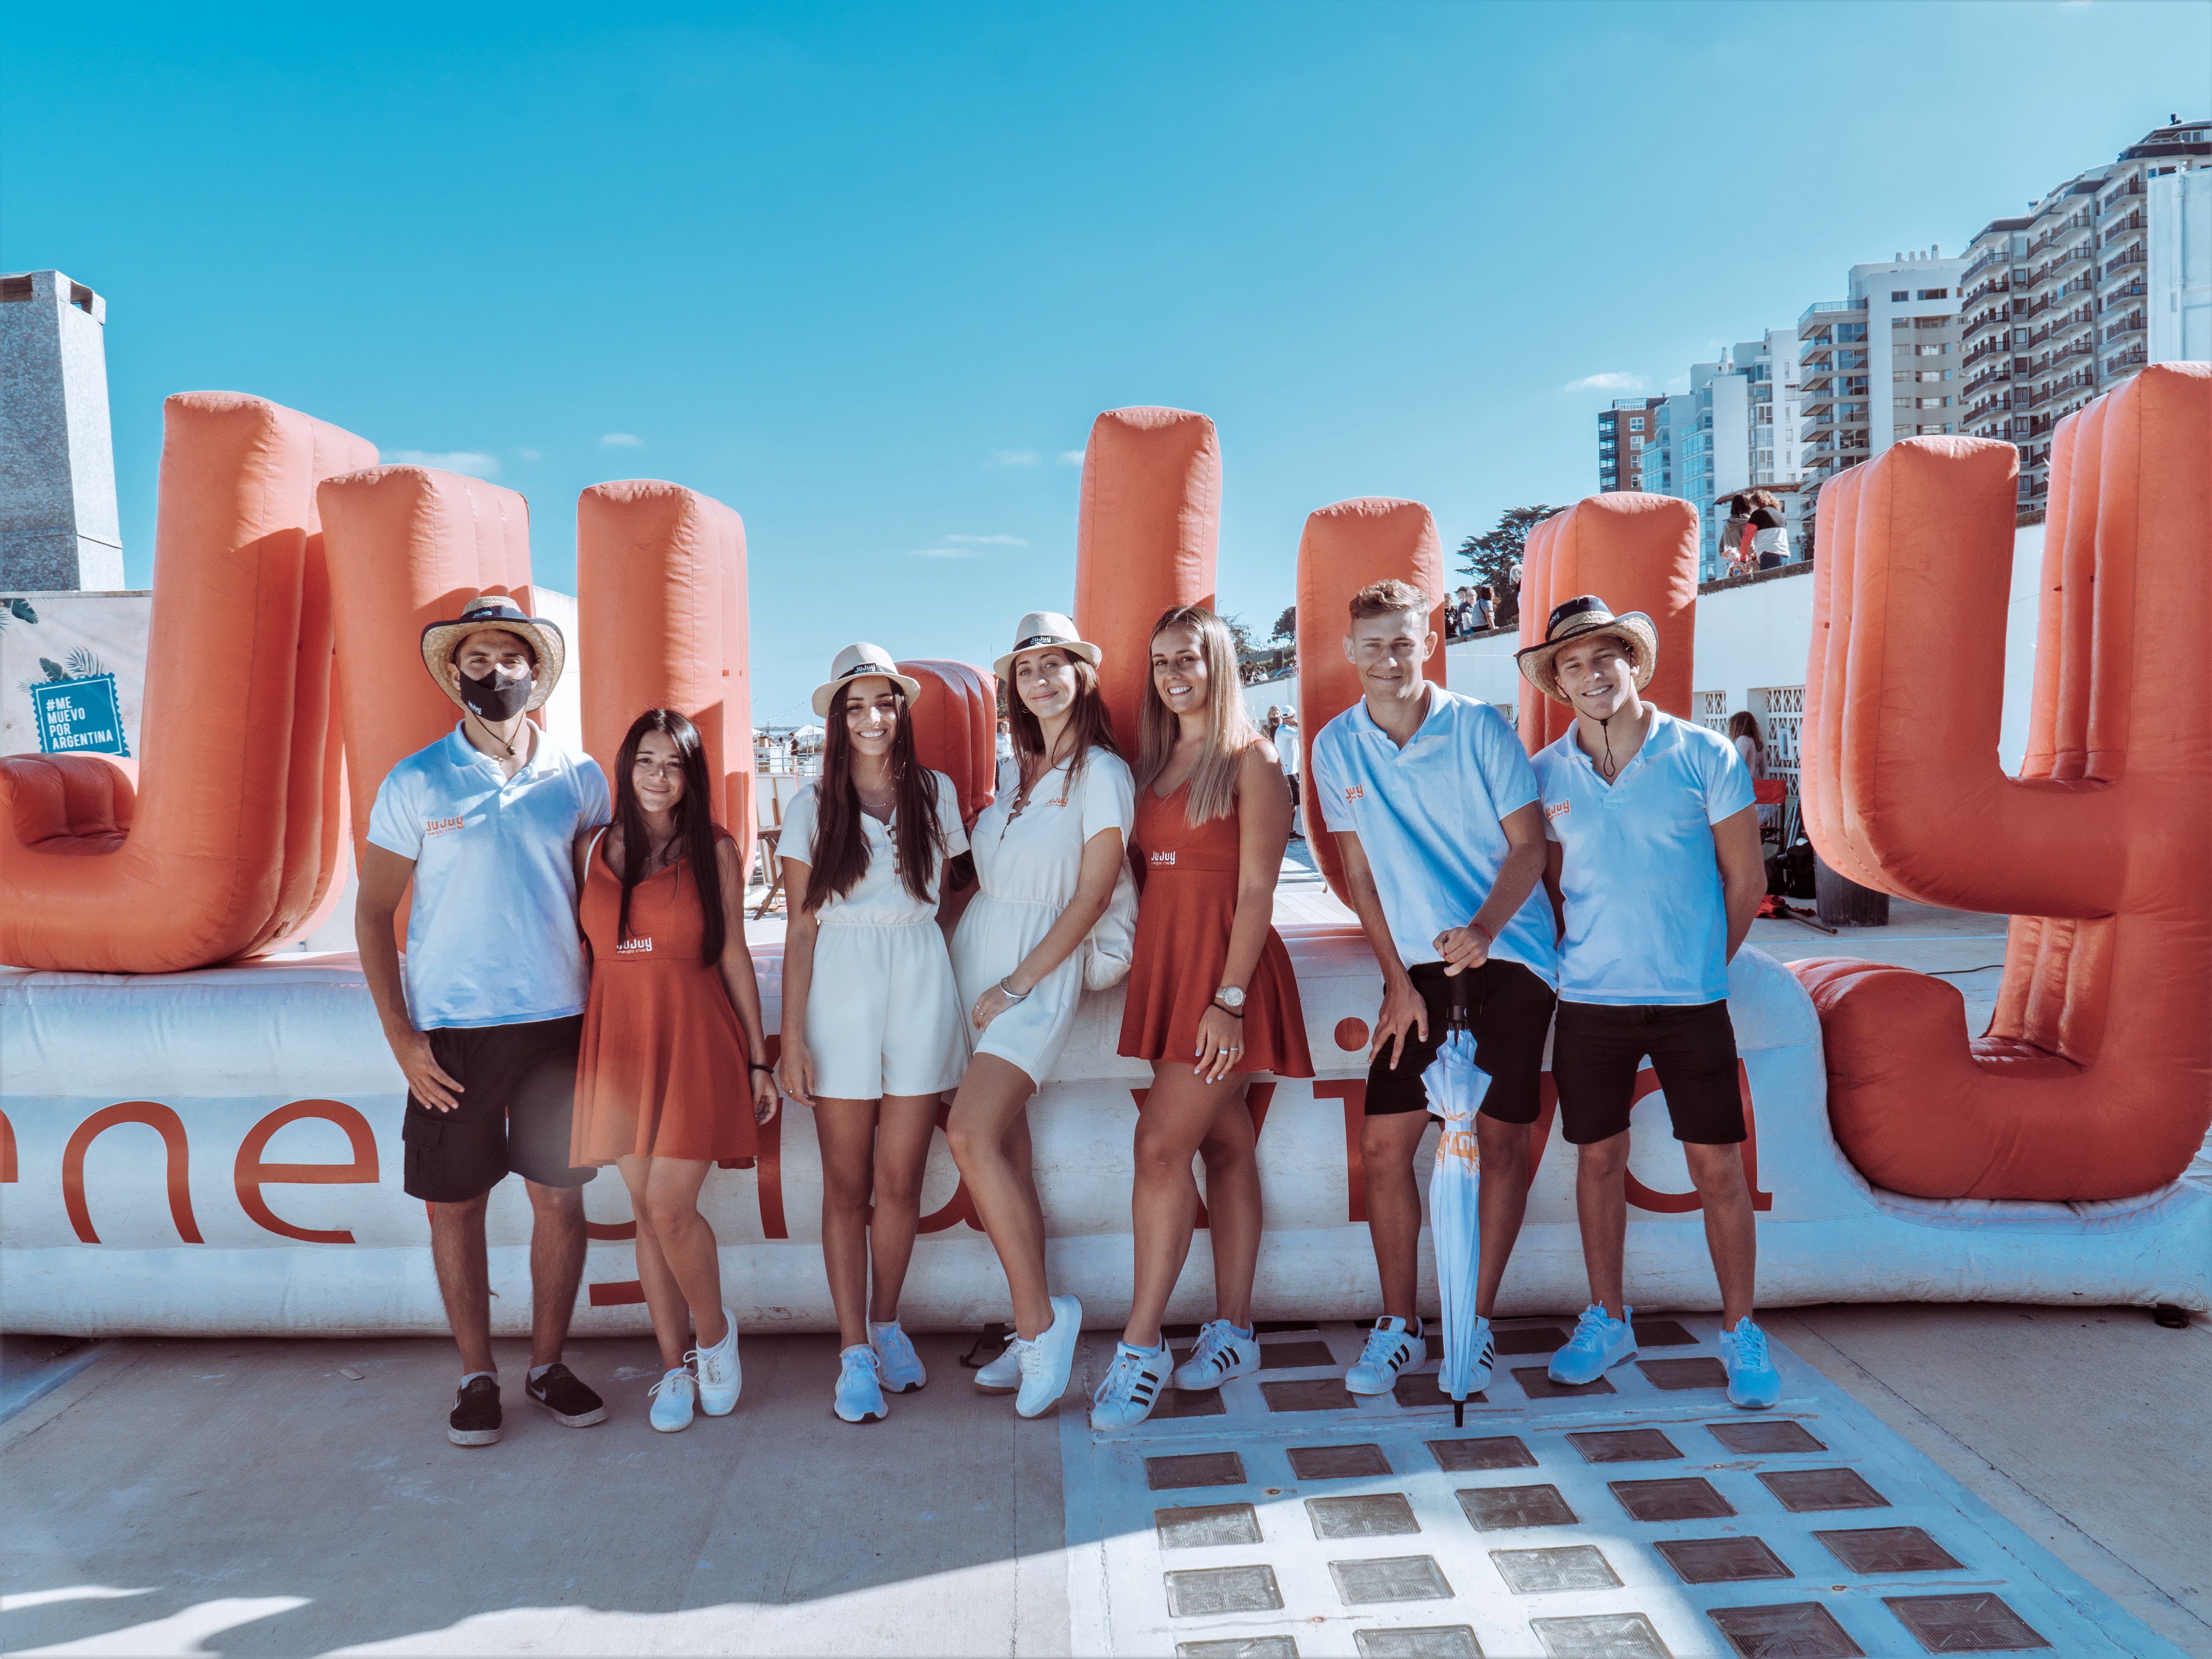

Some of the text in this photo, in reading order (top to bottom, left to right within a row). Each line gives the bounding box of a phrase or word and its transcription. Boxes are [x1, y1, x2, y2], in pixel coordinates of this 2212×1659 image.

[46, 696, 72, 711] #ME
[47, 708, 85, 724] MUEVO
[49, 723, 71, 737] POR
[53, 729, 113, 750] ARGENTINA
